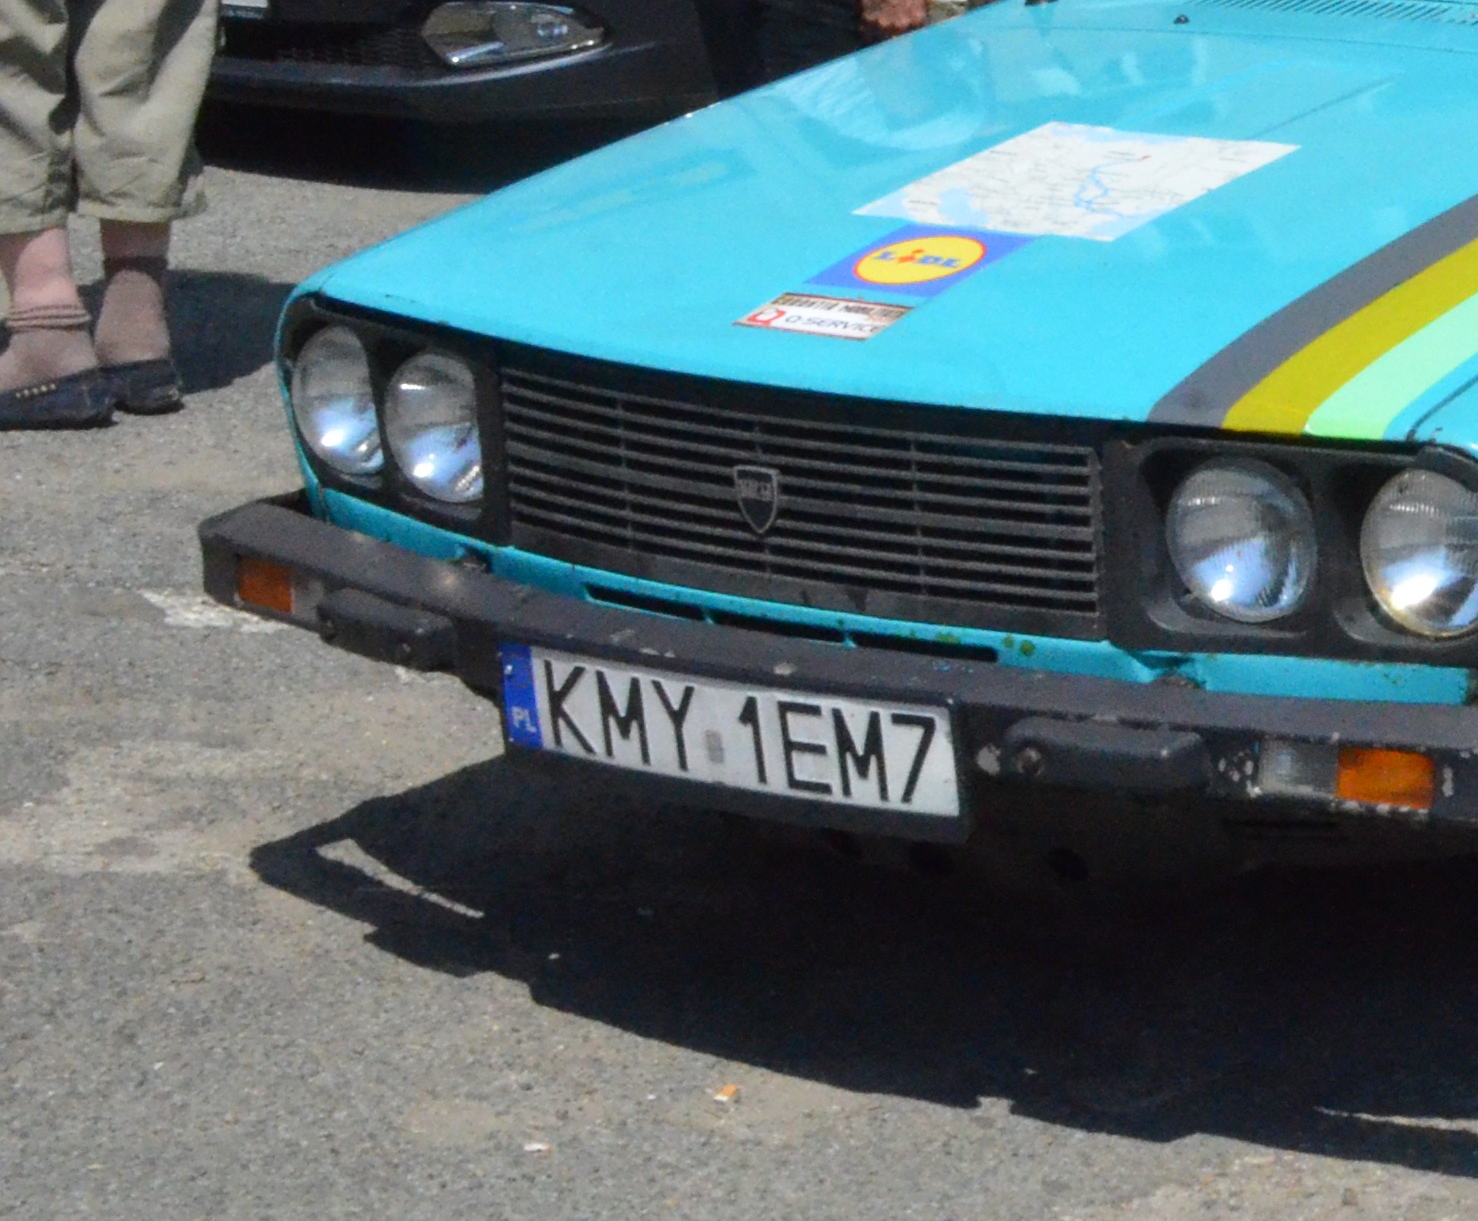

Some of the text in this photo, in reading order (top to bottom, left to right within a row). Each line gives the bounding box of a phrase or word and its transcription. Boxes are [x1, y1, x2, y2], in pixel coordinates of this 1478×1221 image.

[512, 706, 538, 734] PL
[543, 659, 937, 804] KMY 1EM7
